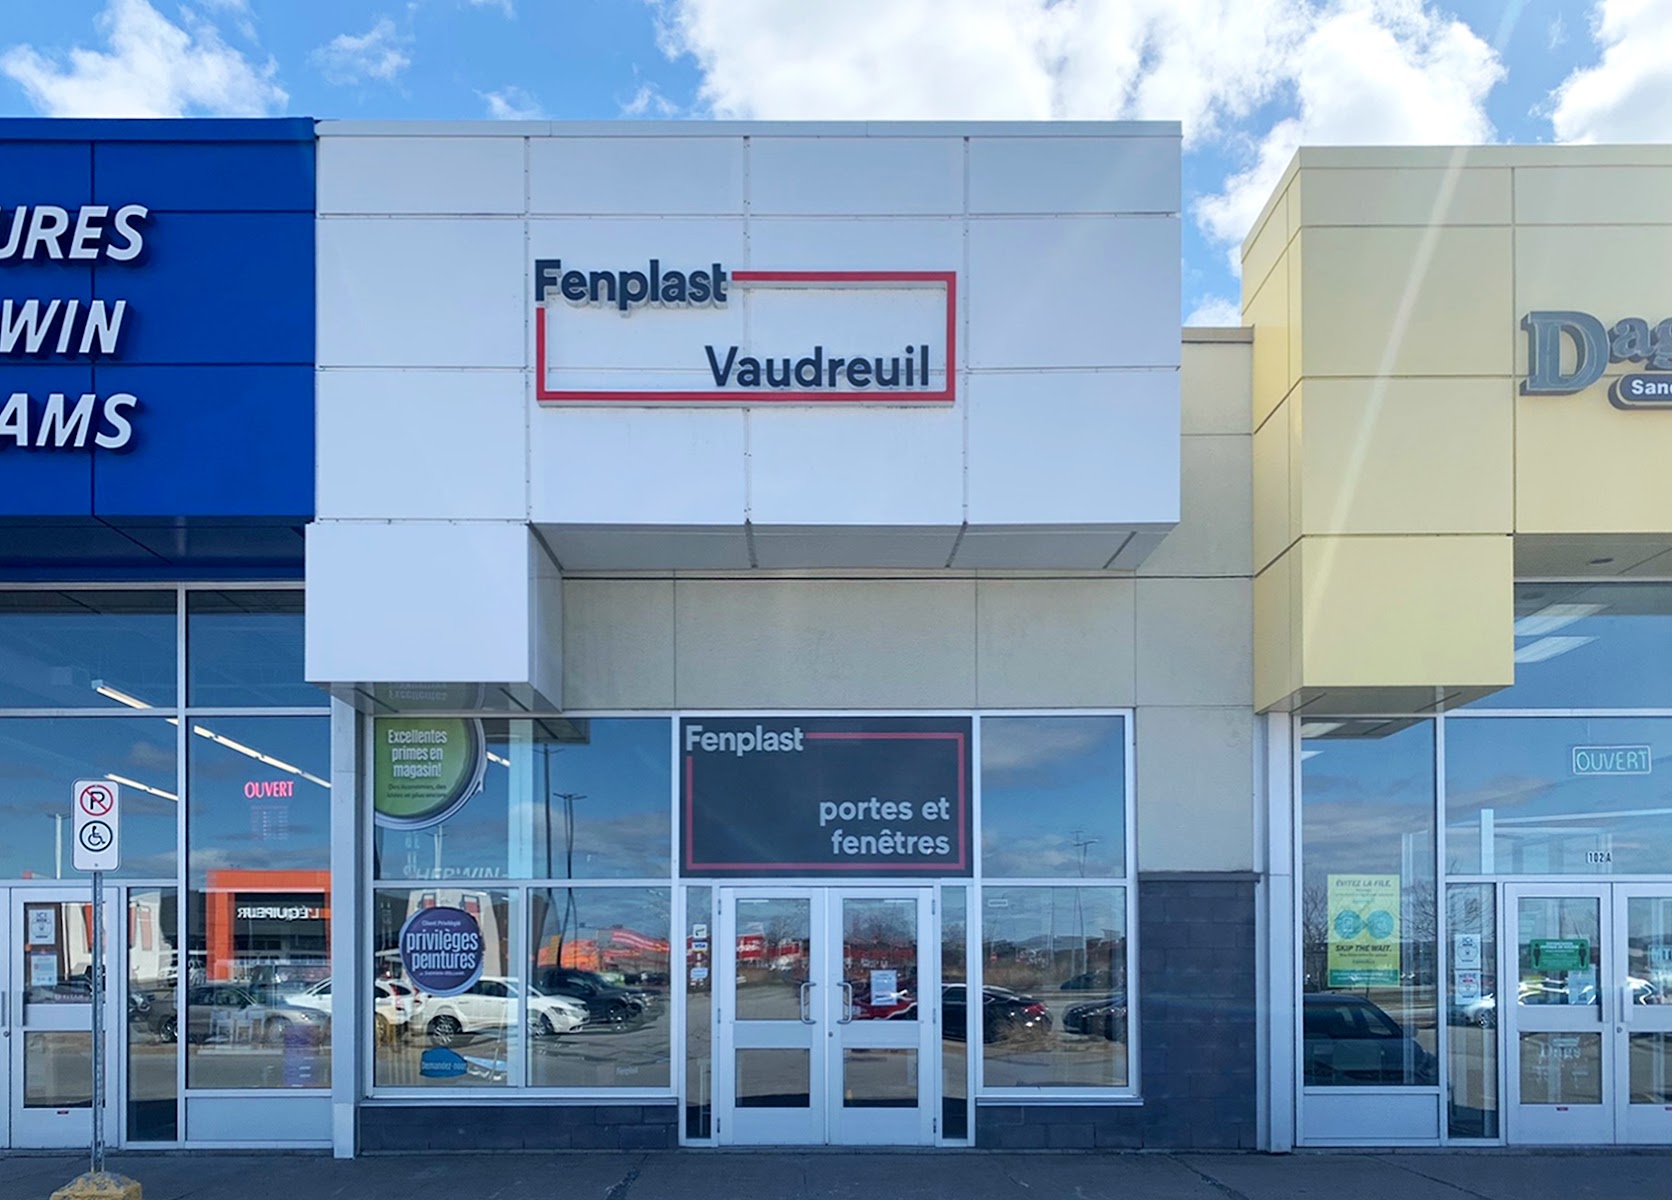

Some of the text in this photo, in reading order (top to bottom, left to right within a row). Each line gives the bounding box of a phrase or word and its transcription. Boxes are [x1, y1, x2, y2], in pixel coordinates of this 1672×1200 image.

[534, 258, 727, 311] Fenplast
[0, 299, 126, 354] WIN
[705, 345, 930, 388] Vaudreuil
[1631, 379, 1672, 395] San
[0, 393, 137, 449] AMS
[387, 729, 448, 744] Excellentes
[685, 725, 804, 757] Fenplast
[391, 745, 444, 762] primes en
[1576, 751, 1647, 771] OUVERT
[393, 762, 442, 779] magasin!
[244, 781, 294, 799] OUVERT
[820, 797, 949, 826] portes et
[831, 829, 950, 855] fenêtres
[406, 928, 479, 954] privilèges
[1355, 944, 1370, 952] THE
[412, 951, 476, 972] peintures
